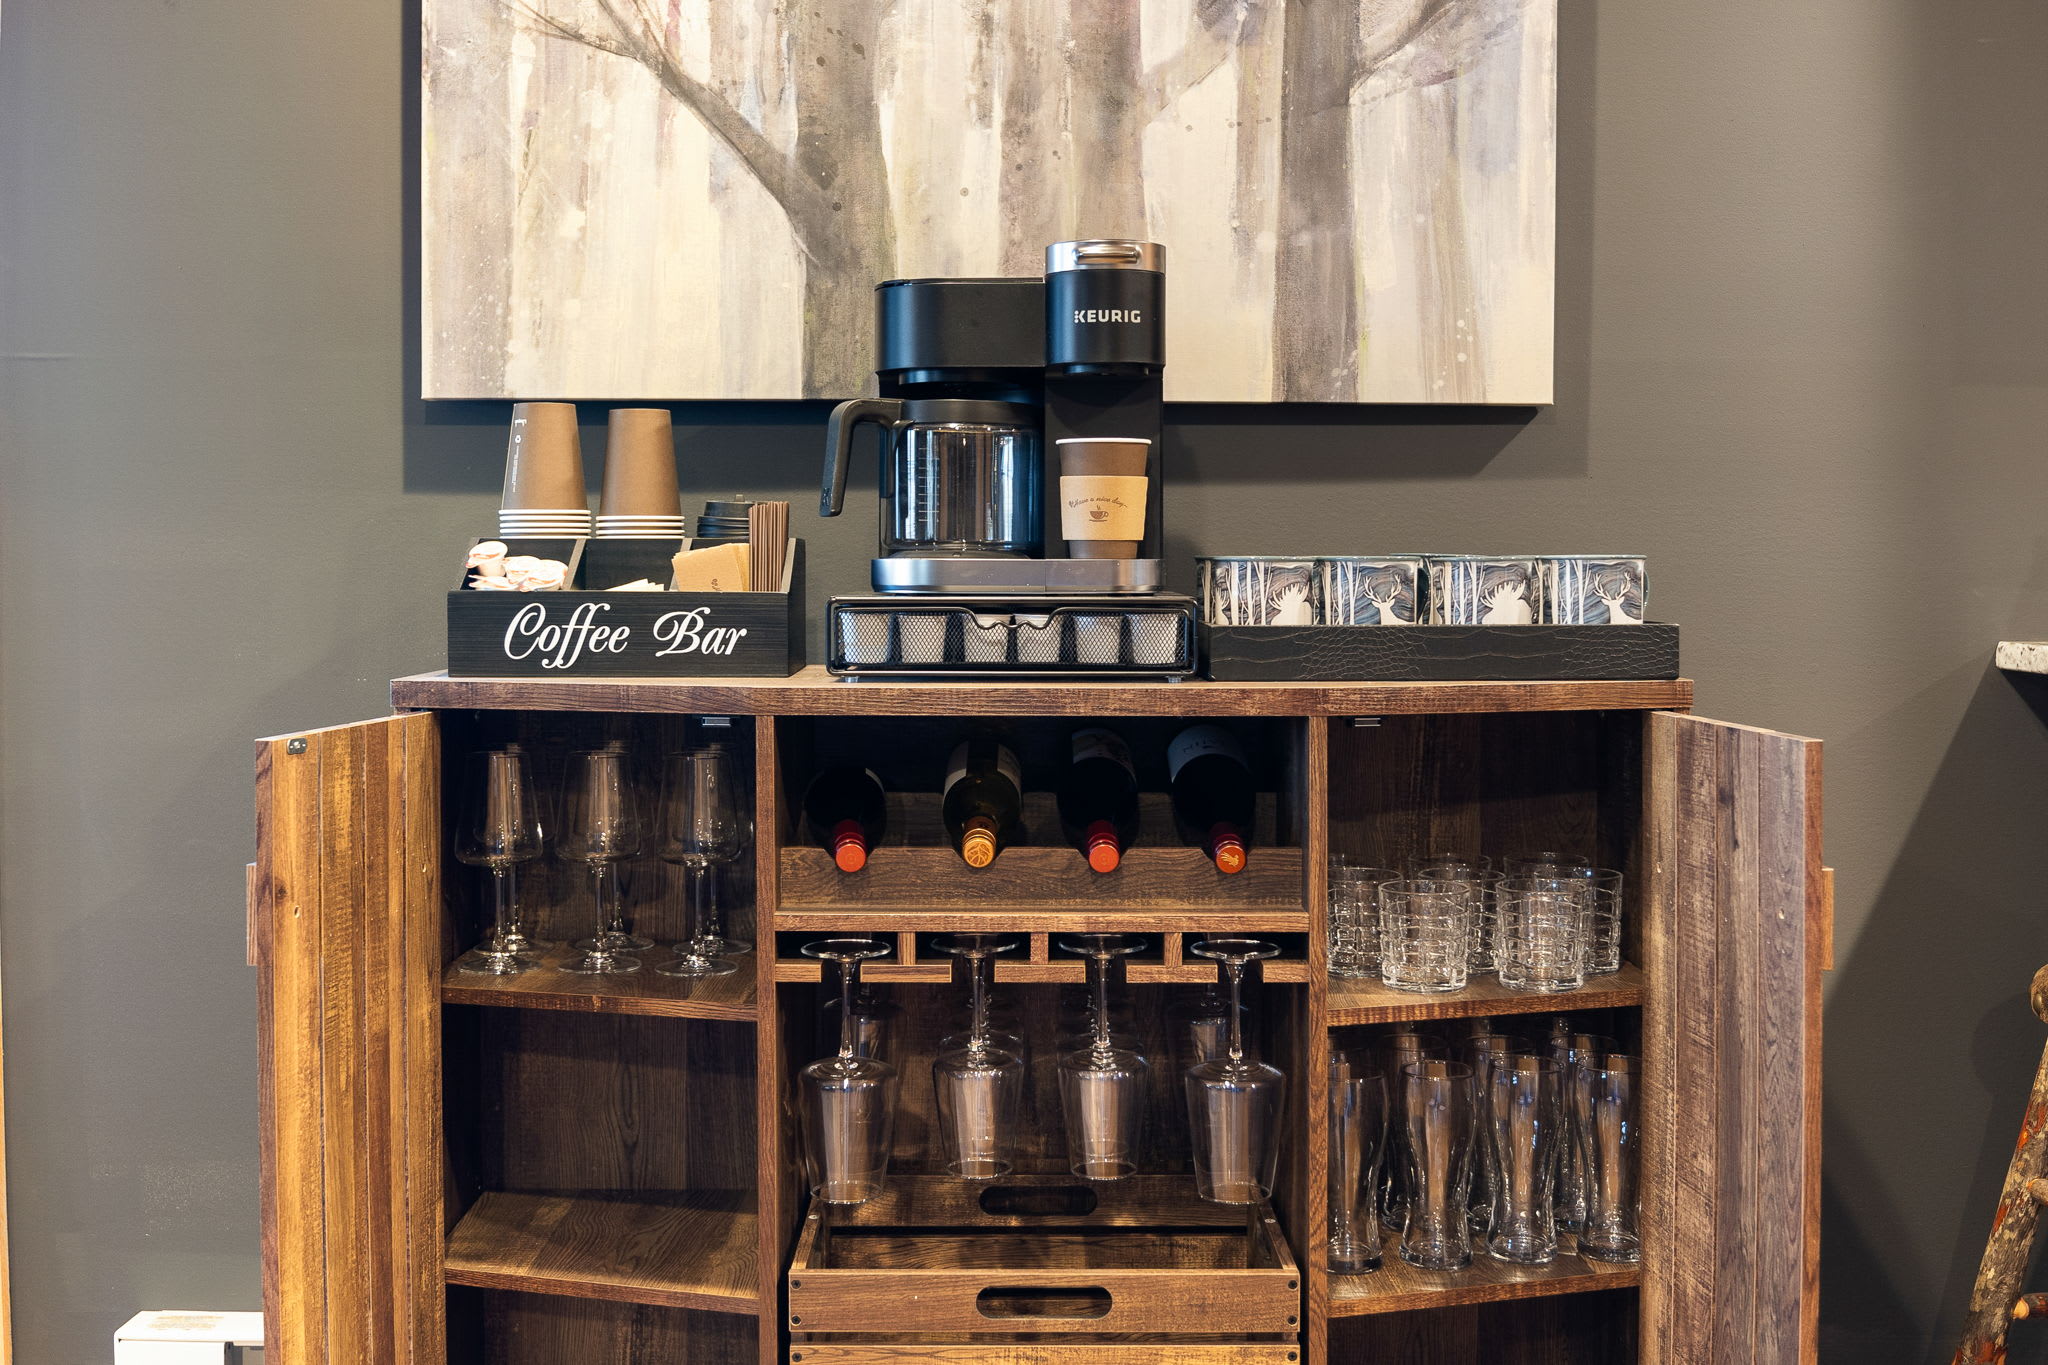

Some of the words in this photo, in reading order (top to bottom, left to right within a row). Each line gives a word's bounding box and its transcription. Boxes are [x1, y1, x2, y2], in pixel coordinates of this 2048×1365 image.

[1074, 309, 1141, 324] KEURIG
[504, 602, 631, 669] Coffee
[653, 606, 748, 657] Bar
